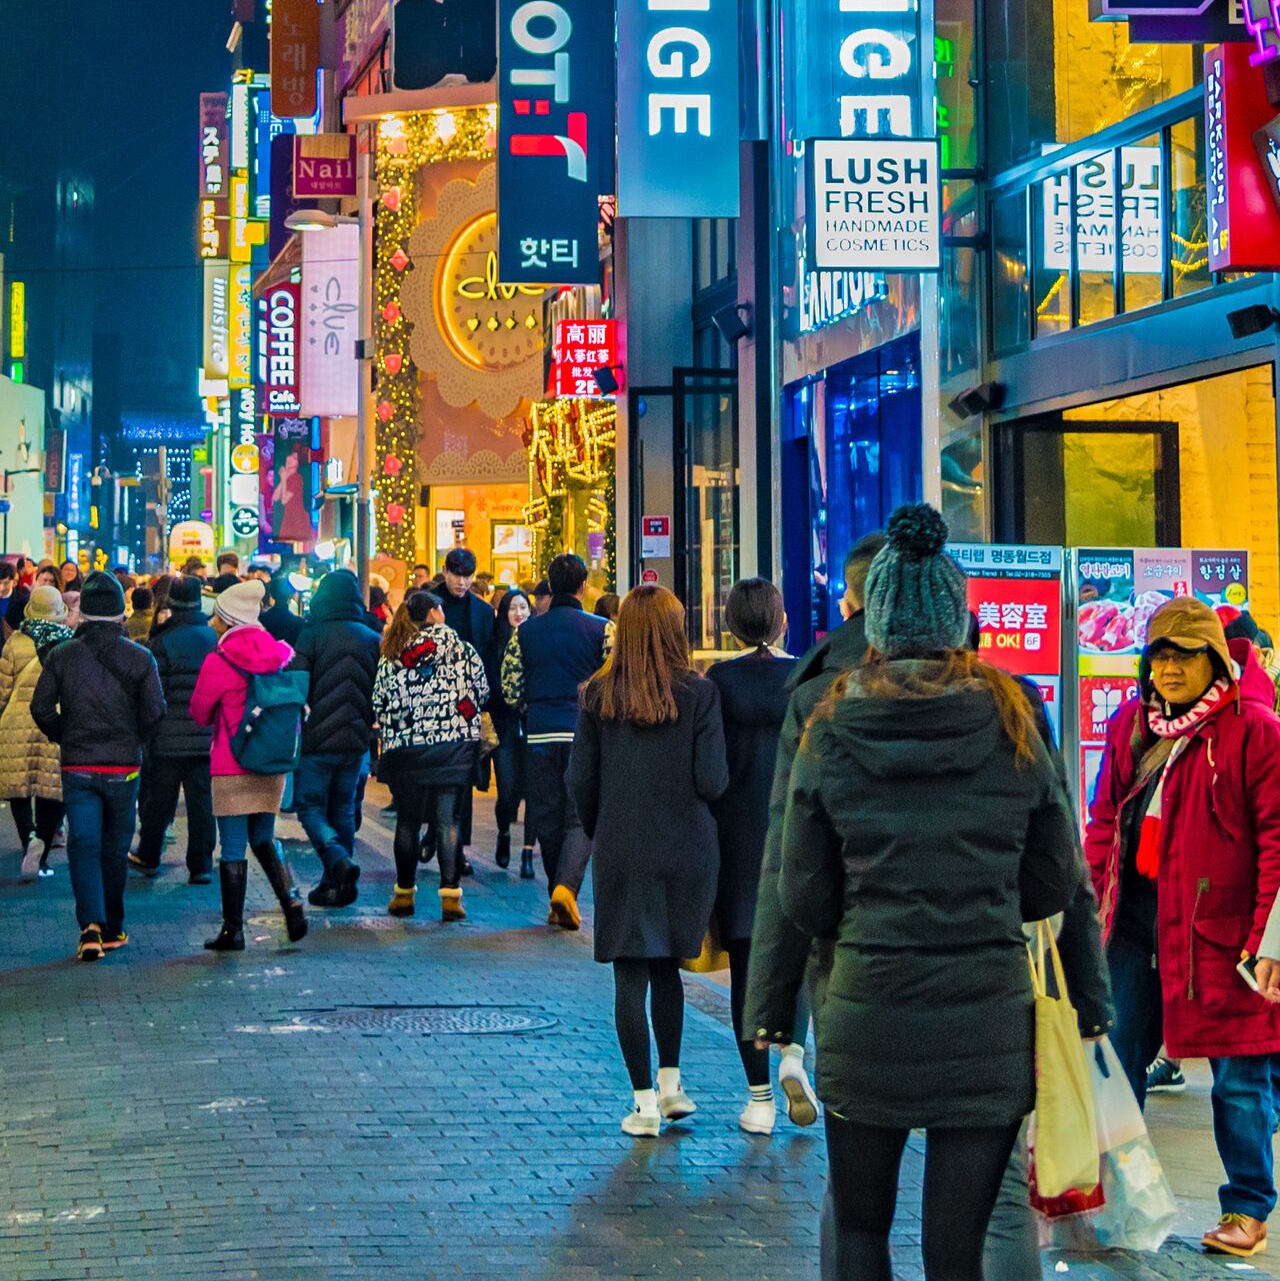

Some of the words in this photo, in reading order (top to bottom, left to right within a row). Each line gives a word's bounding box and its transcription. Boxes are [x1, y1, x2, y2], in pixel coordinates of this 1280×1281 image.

[298, 159, 353, 179] Nail
[824, 157, 929, 185] LUSH
[825, 191, 929, 214] FRESH
[825, 219, 929, 234] HANDMADE
[519, 237, 579, 269] 핫티
[826, 238, 930, 253] COSMETICS
[270, 289, 295, 387] COFFEE
[566, 323, 608, 345] 高丽
[571, 366, 599, 378] 批发
[269, 390, 296, 405] Cafe
[991, 549, 1052, 565] 명동월드점
[978, 602, 1048, 630] 美容室
[995, 633, 1021, 648] OK!
